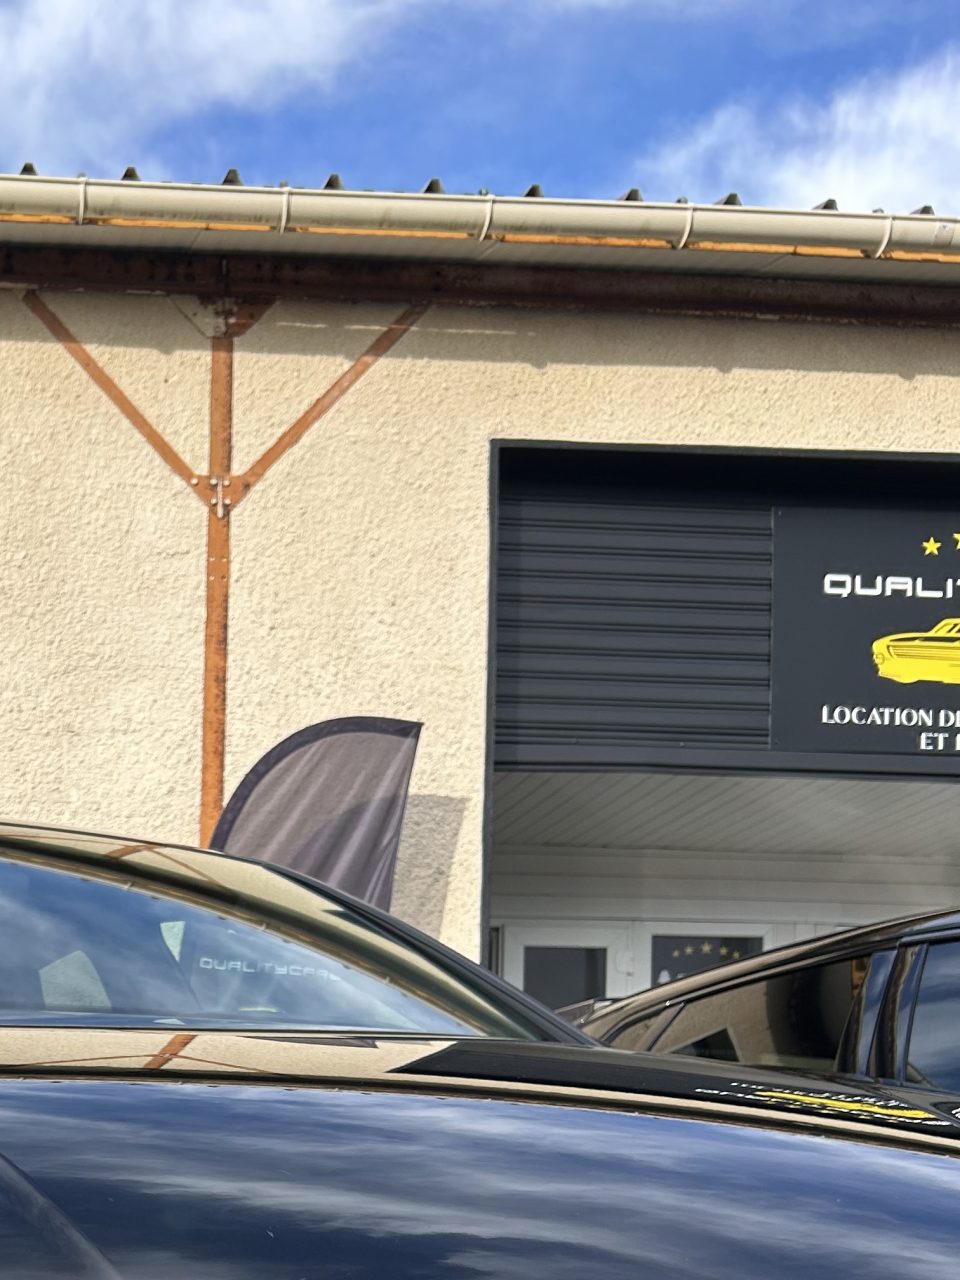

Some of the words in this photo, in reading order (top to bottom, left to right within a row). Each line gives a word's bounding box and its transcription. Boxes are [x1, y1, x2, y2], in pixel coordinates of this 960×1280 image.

[823, 573, 960, 599] QUALI
[821, 704, 933, 727] LOCATION
[920, 732, 949, 750] ET
